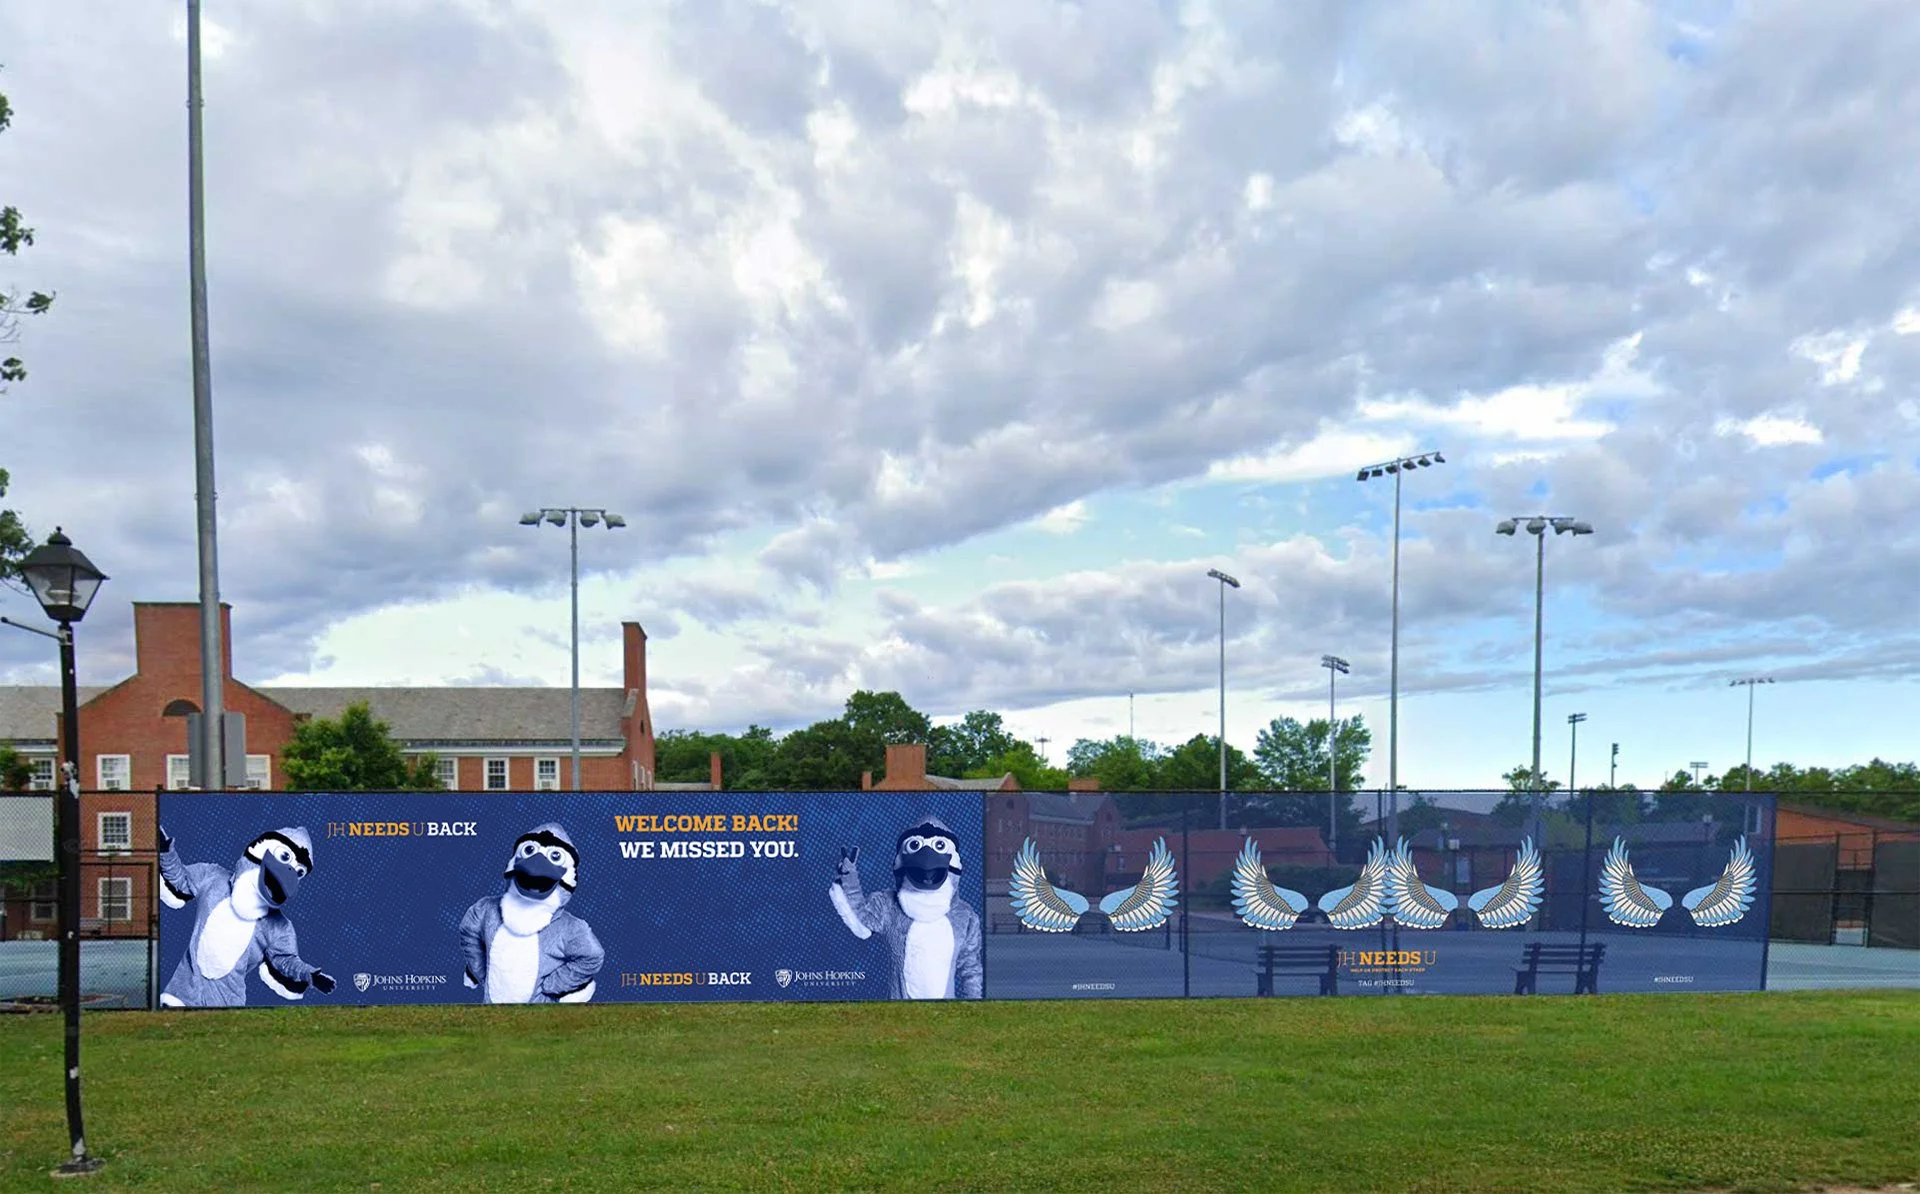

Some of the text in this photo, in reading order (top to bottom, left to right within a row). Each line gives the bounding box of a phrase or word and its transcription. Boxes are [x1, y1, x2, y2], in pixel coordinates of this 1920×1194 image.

[327, 822, 477, 838] JH NEEDS U BACK
[614, 815, 799, 832] WELCOME BACK!
[619, 841, 799, 858] WE MISSED YOU.
[1336, 951, 1436, 968] JH NEEDS U
[372, 974, 447, 987] JOHNS HOPKINS
[621, 972, 751, 988] JH NEEDS U BACK
[793, 971, 866, 982] JOHNS HOPKINS
